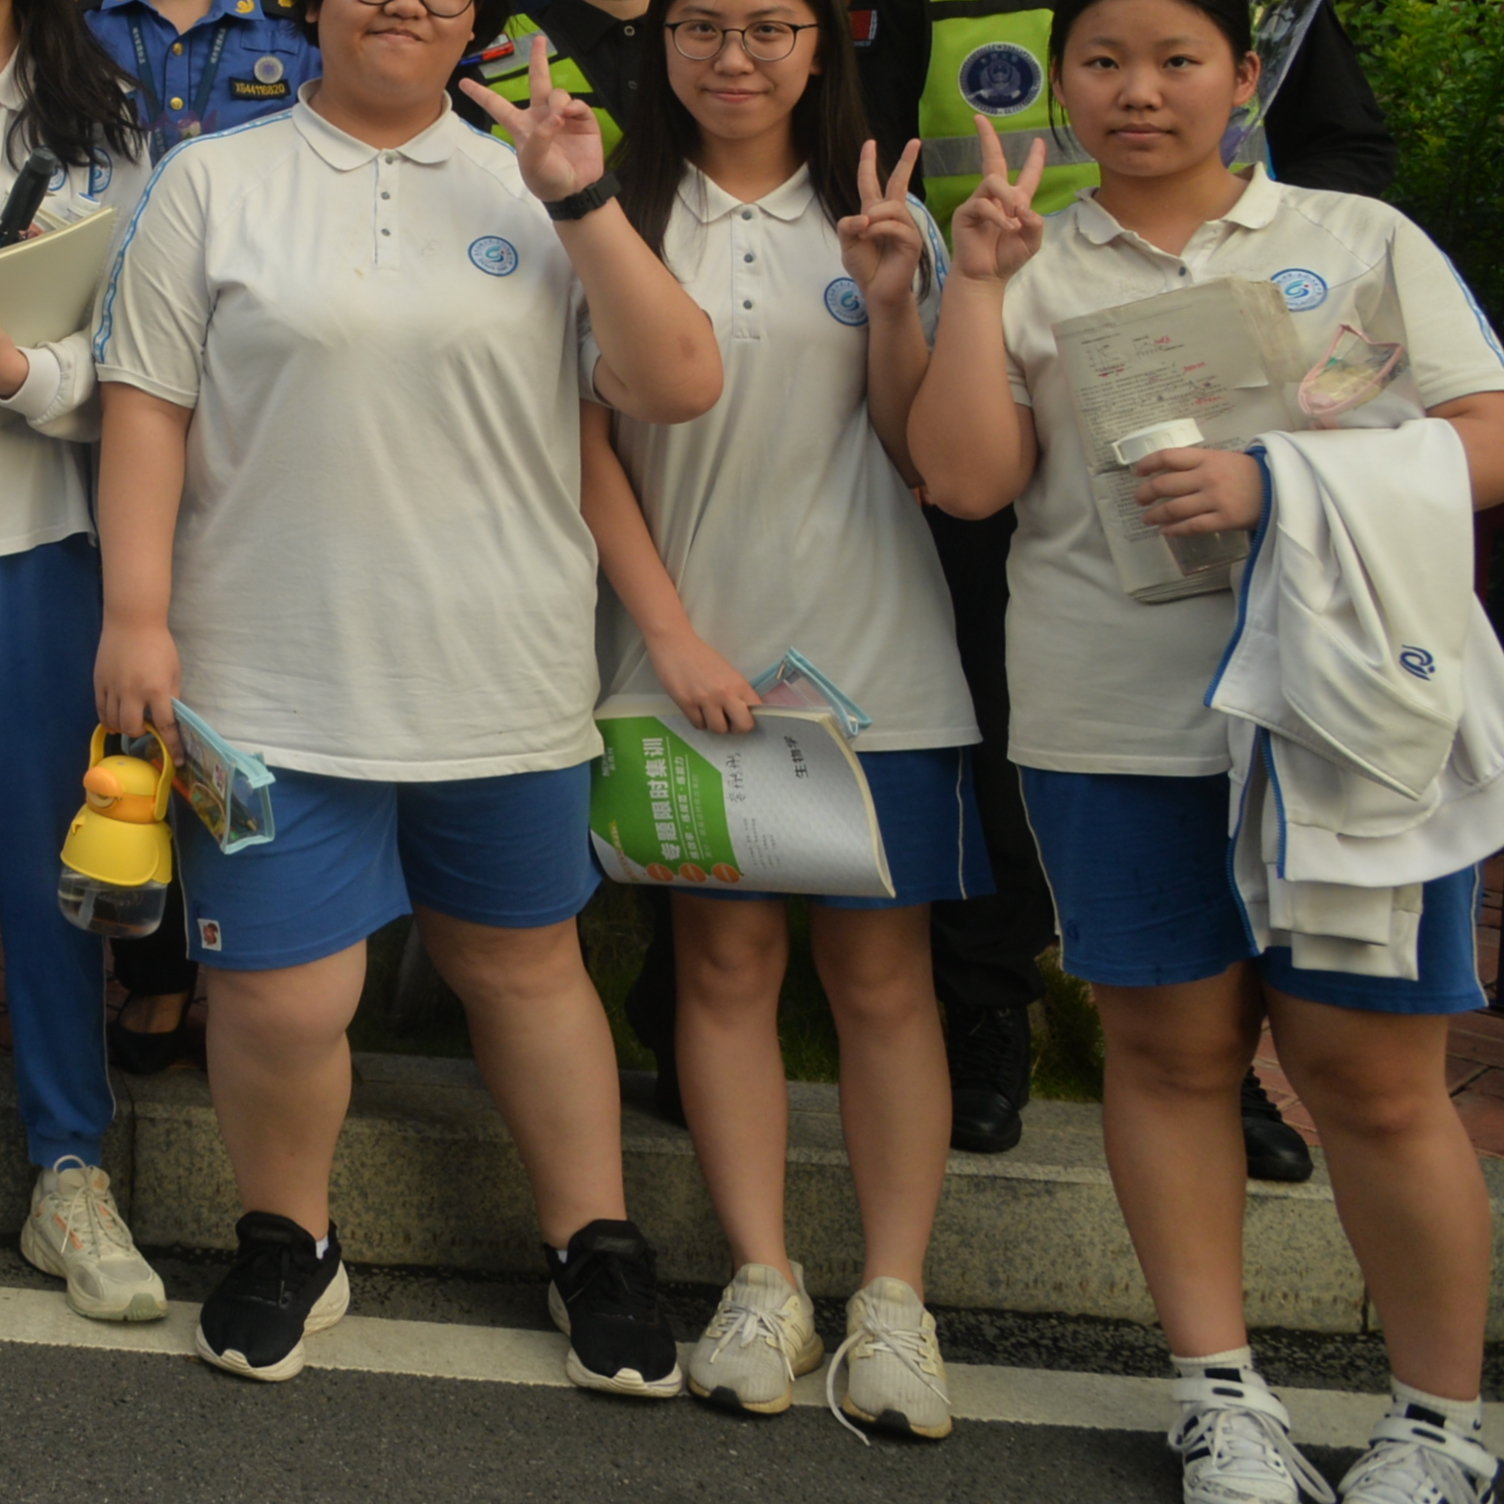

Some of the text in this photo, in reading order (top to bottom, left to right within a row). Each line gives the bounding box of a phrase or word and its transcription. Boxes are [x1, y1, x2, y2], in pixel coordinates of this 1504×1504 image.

[642, 737, 681, 861] 专题限时集训
[783, 735, 808, 779] 生物学
